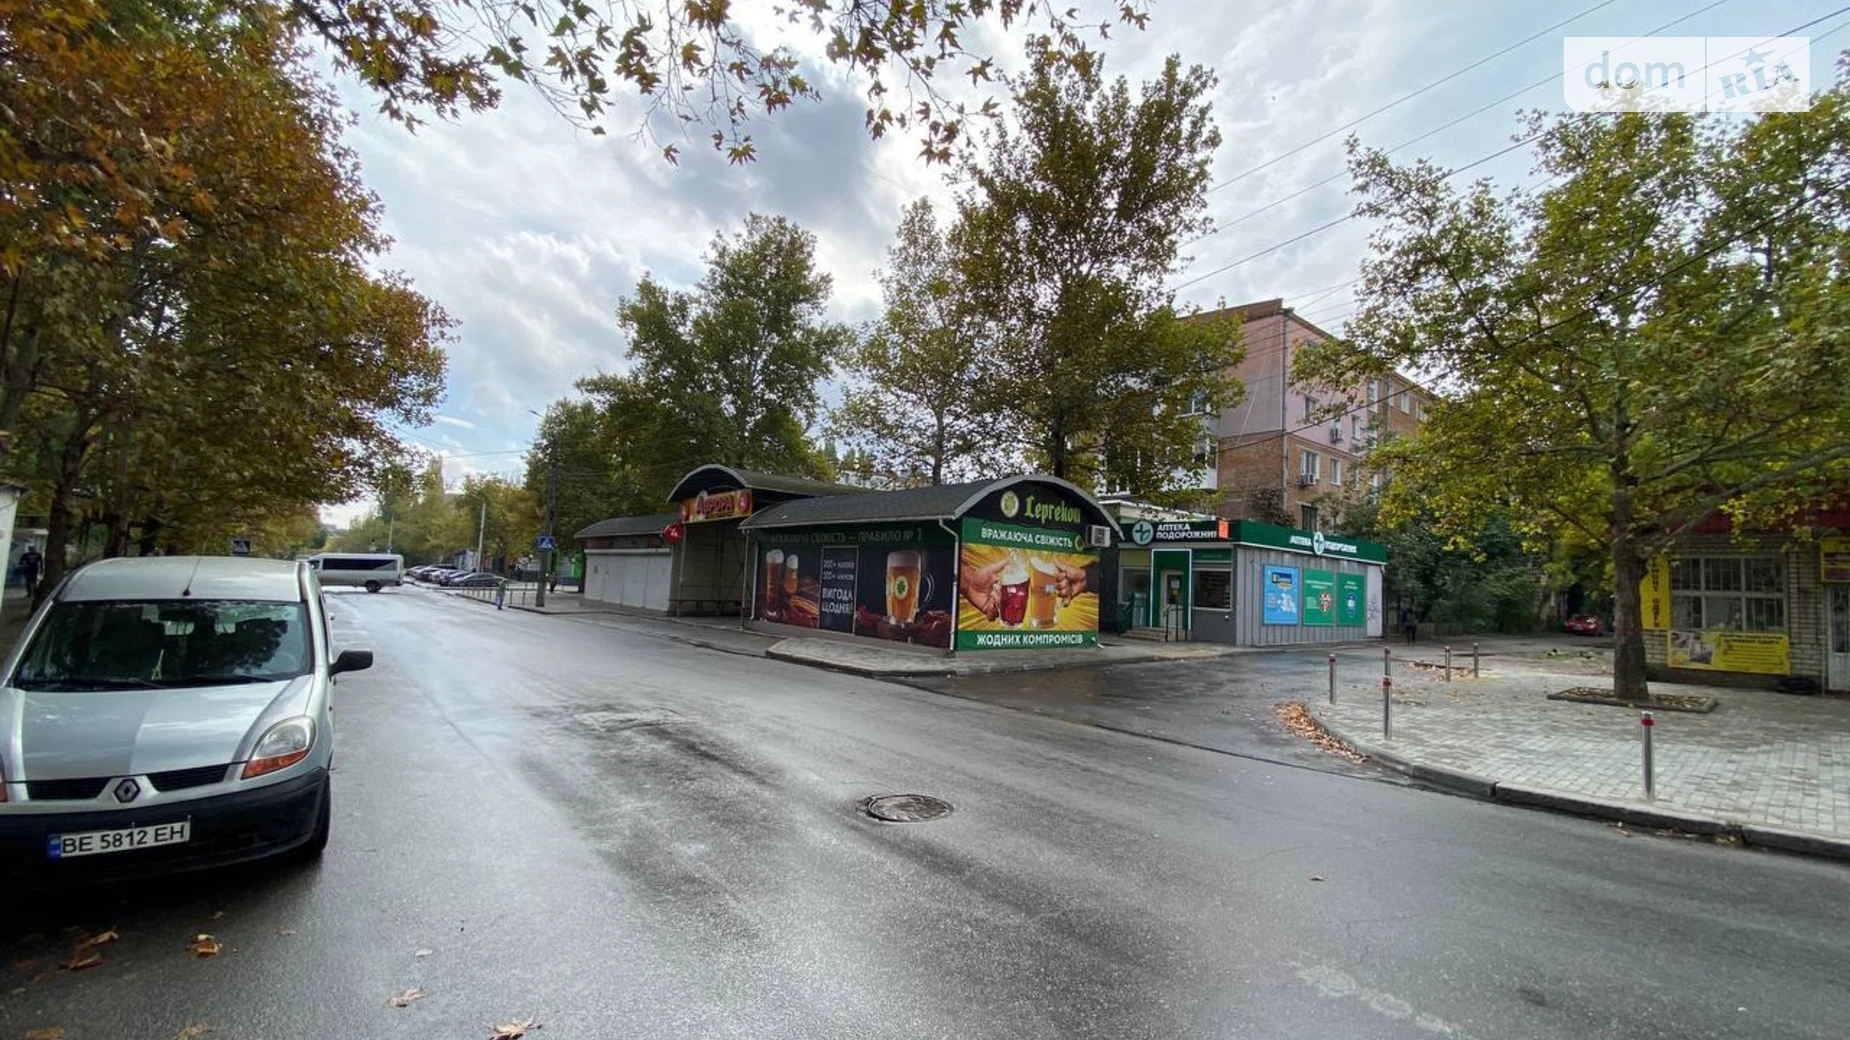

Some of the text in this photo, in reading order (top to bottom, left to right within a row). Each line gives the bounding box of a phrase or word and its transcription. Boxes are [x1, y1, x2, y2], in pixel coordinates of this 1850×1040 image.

[1024, 495, 1081, 524] Leprekon
[1157, 523, 1191, 531] АПТЕКА
[857, 531, 901, 543] ПРАВИЛО
[917, 528, 922, 541] 1
[981, 527, 1073, 548] ВРАЖАЮЧА СВІЖІСТЬ
[822, 588, 853, 600] ВИГОДА
[977, 634, 1084, 646] ЖОДНИХ КОМПРОМІСІВ
[62, 825, 185, 853] BE 5812 EH
